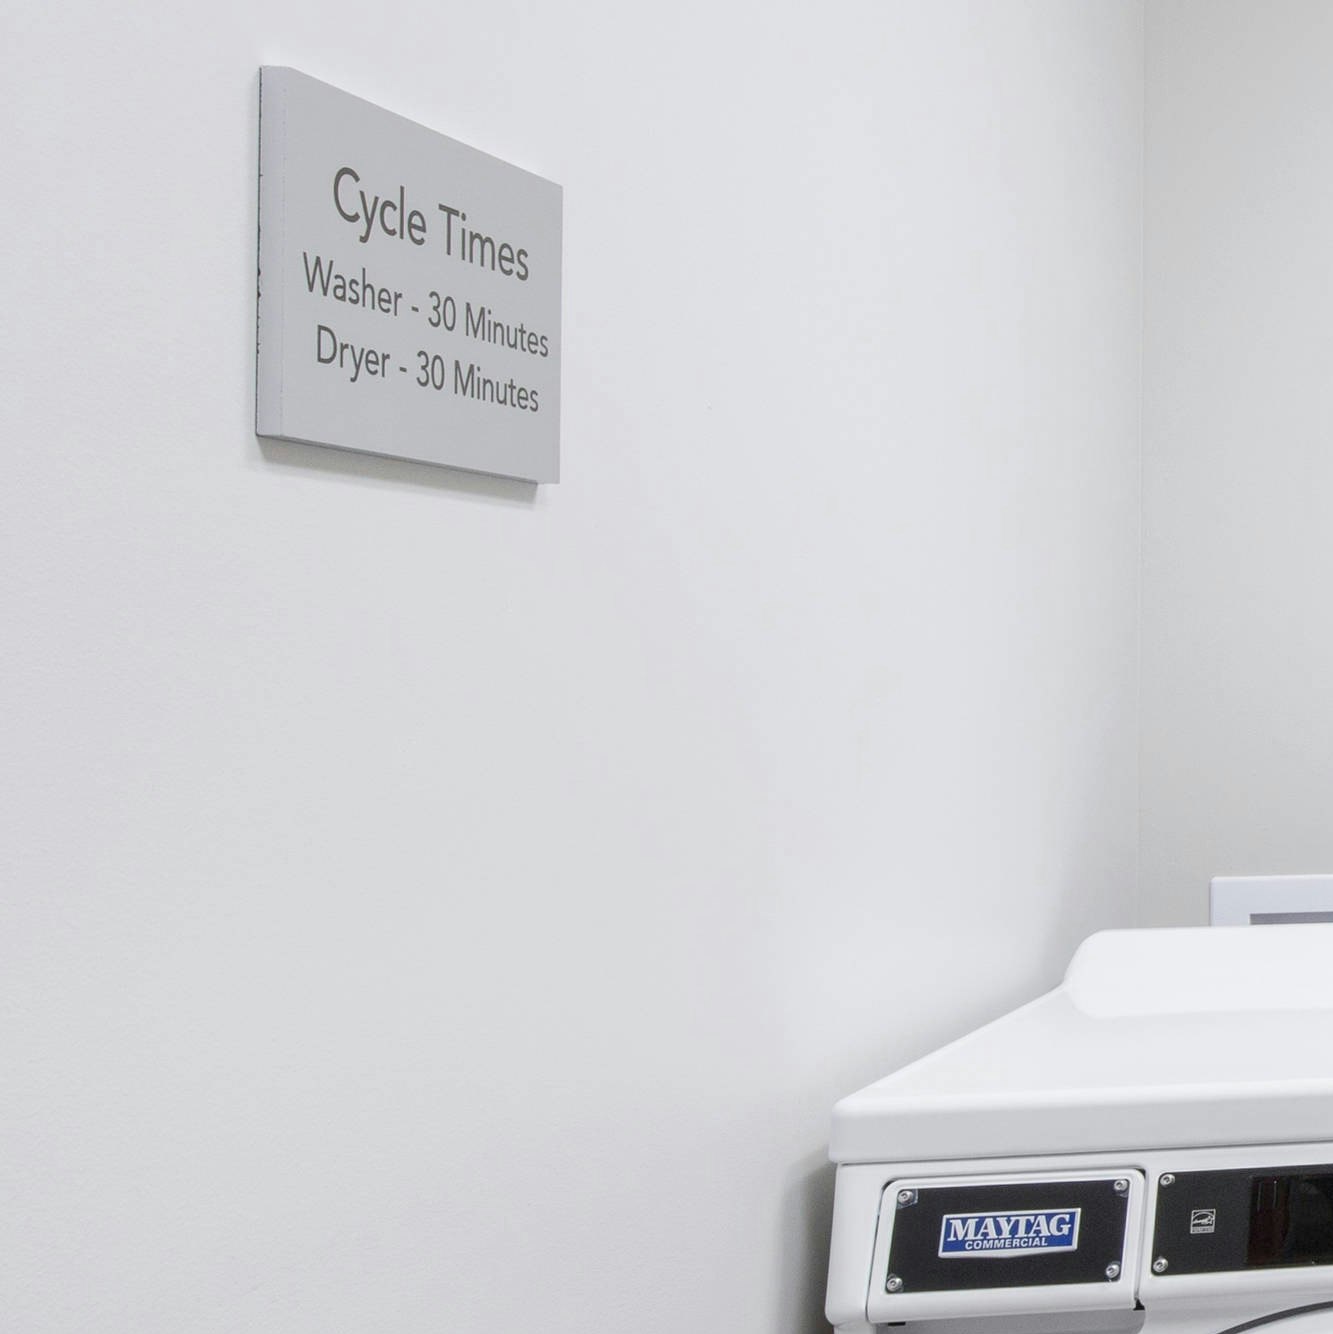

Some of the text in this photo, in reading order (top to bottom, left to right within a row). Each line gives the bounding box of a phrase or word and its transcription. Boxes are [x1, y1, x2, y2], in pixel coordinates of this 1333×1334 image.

[333, 167, 529, 281] Cycle Times
[302, 251, 402, 317] Washer
[428, 291, 456, 332] 30
[465, 302, 549, 358] Minutes
[316, 324, 390, 383] Dryer
[416, 350, 445, 390] 30
[454, 360, 539, 412] Minutes
[947, 1214, 1072, 1241] MAYTAG
[965, 1238, 1048, 1250] COMMERCIAL
